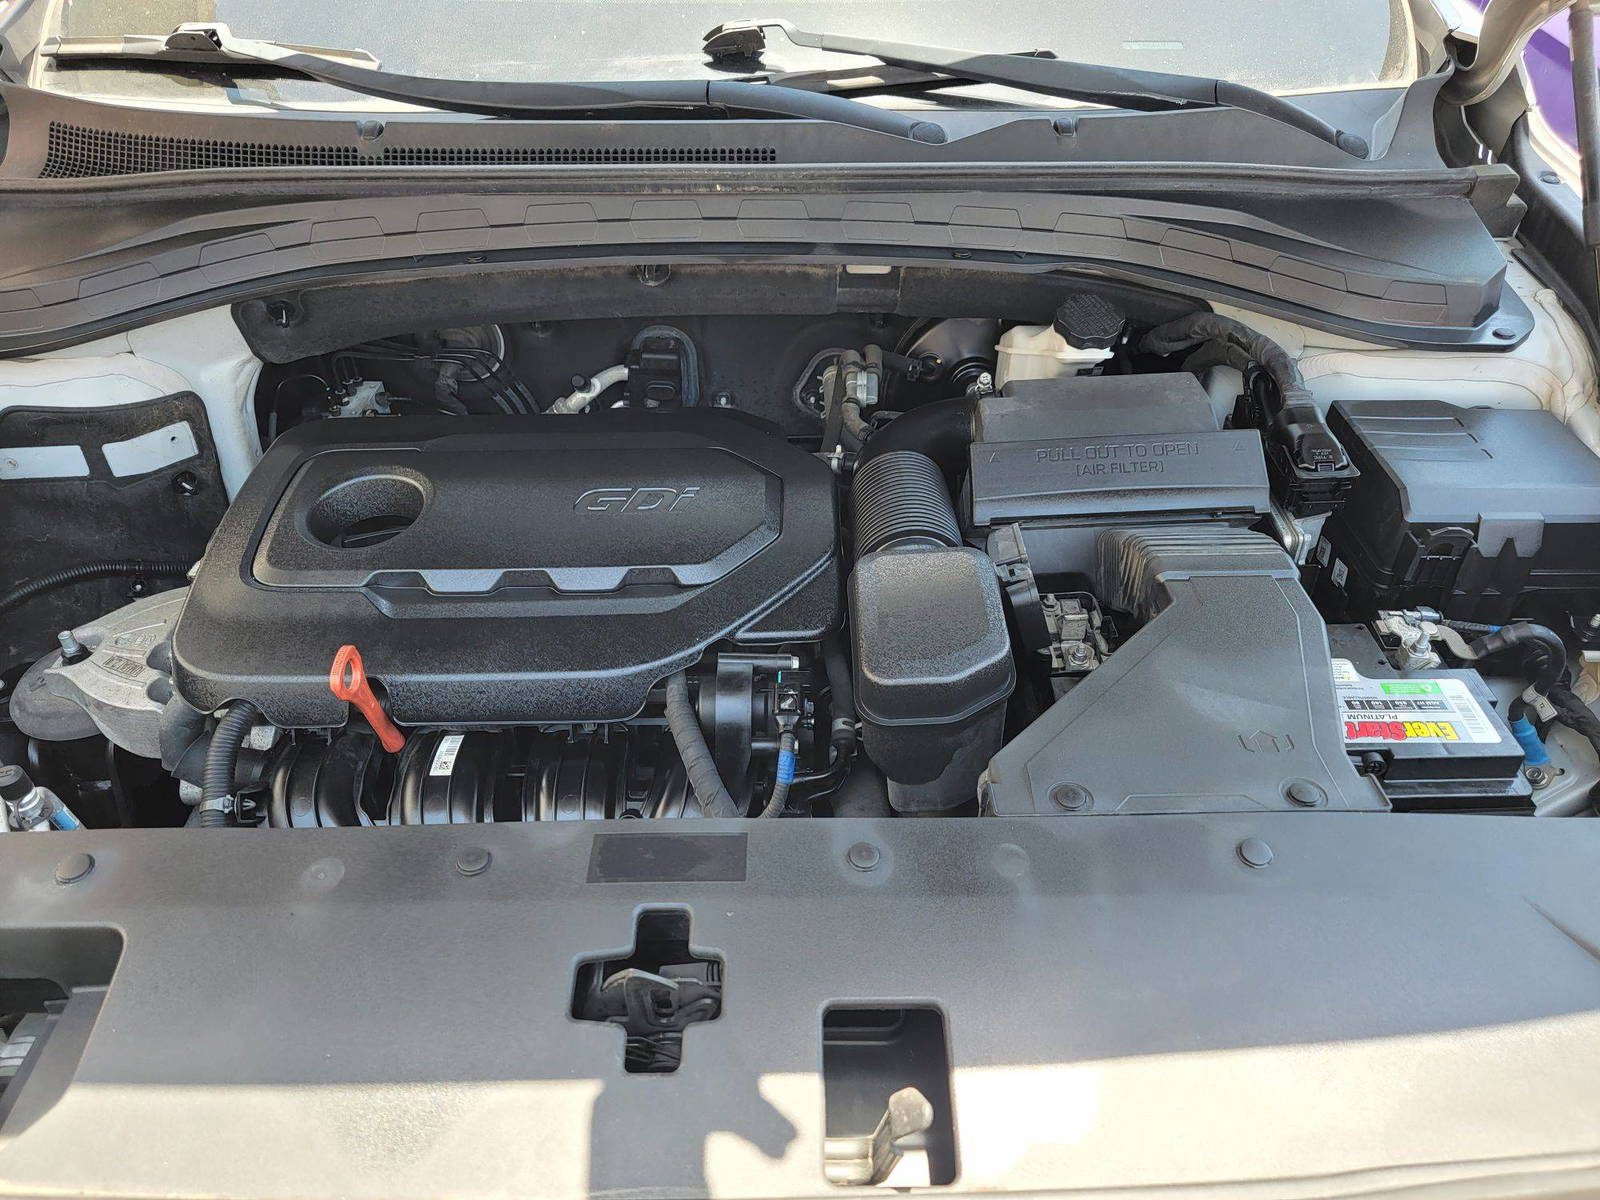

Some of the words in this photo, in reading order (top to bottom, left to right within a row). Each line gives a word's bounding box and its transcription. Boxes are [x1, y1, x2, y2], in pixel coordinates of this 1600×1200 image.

[1035, 446, 1080, 463] PULL
[1085, 443, 1120, 459] OUT
[1122, 442, 1147, 458] TO
[1152, 440, 1199, 457] OPEN
[1345, 721, 1460, 741] EverStart
